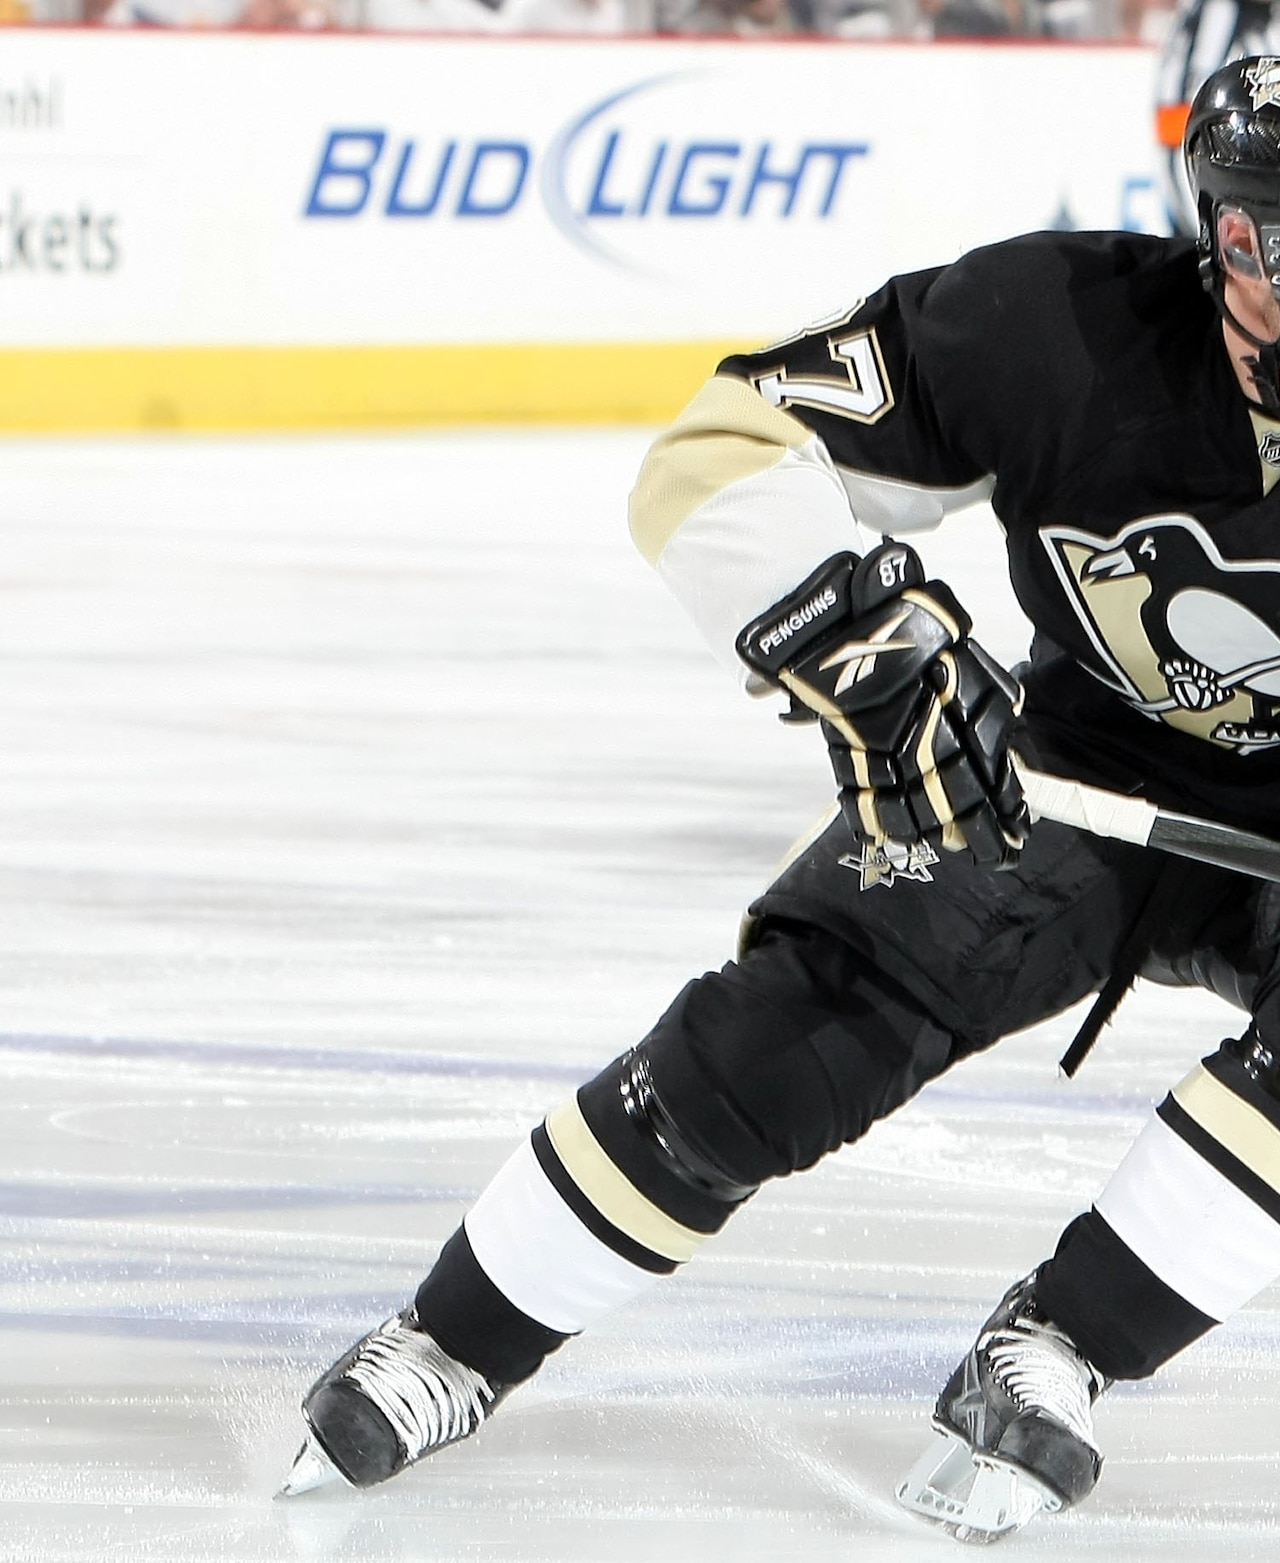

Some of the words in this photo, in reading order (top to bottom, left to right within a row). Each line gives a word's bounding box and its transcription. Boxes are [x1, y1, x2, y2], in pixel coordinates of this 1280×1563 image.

[303, 129, 531, 218] BUD
[586, 129, 871, 218] LIGHT
[0, 184, 122, 274] kets
[878, 551, 908, 588] 87
[758, 586, 839, 656] PENGUINS
